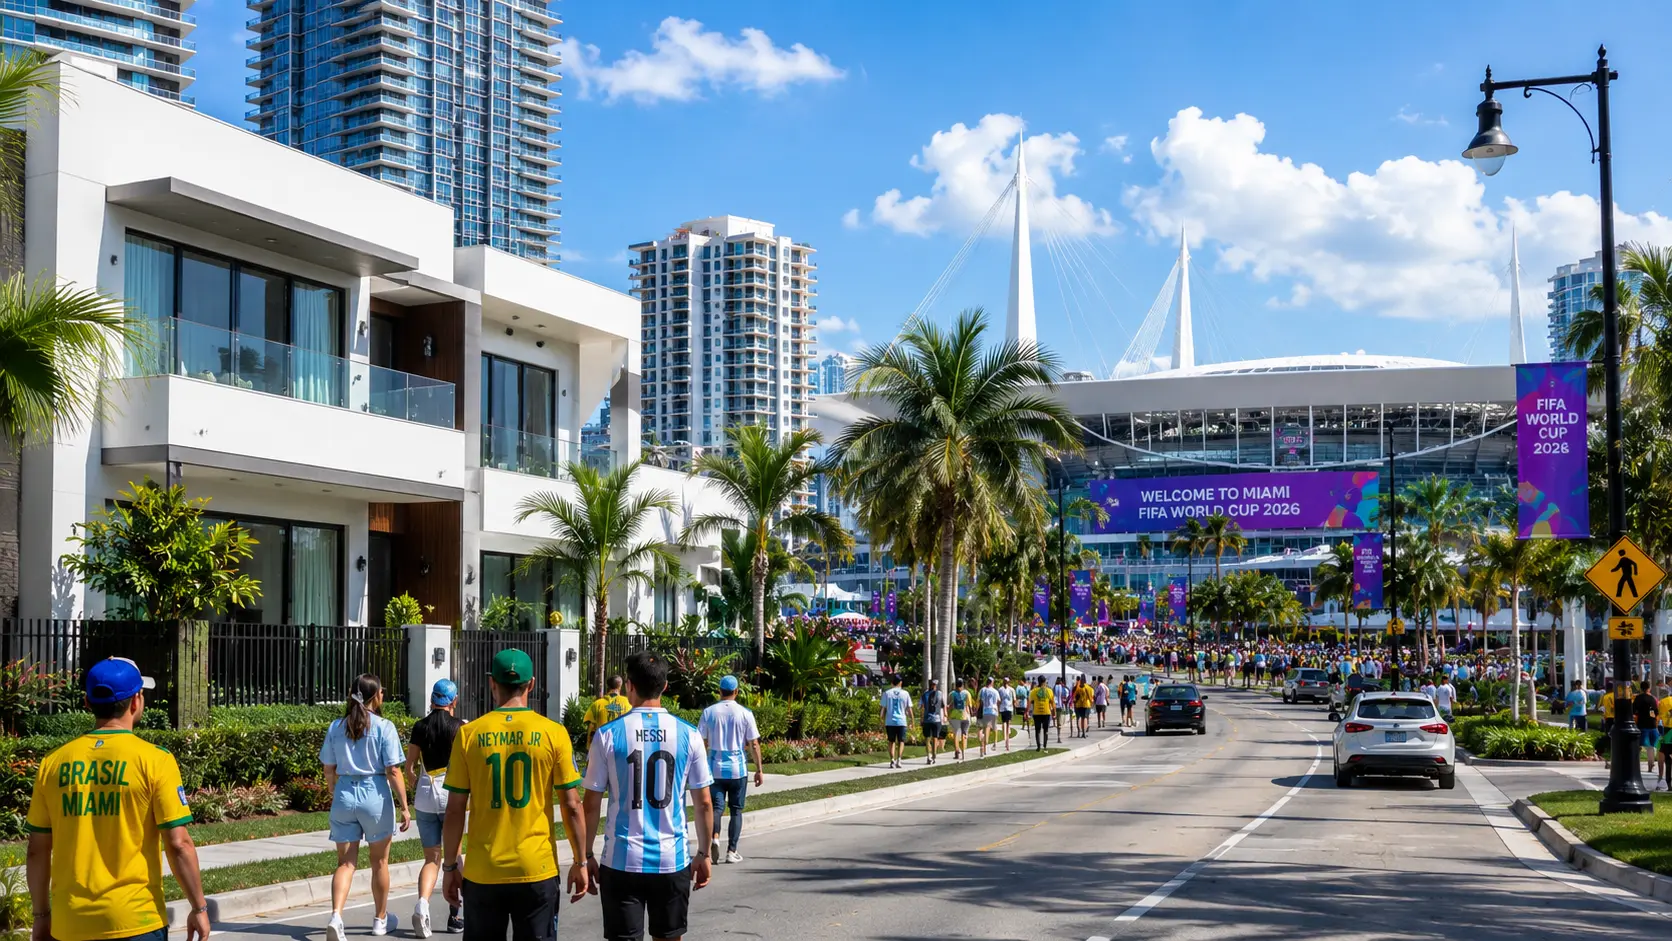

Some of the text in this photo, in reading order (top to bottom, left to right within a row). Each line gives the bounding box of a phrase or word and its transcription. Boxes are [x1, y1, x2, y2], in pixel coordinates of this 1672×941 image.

[1537, 398, 1567, 411] FIFA
[1525, 412, 1579, 425] WORLD
[1538, 427, 1568, 439] CUP
[1141, 485, 1290, 503] WELCOME TO MIAMI
[1138, 502, 1301, 519] FIFA WORLD CUP 2026
[477, 730, 542, 748] NEYMAR JR
[58, 760, 130, 788] BRASIL
[485, 751, 533, 809] 10
[626, 748, 676, 810] 10
[61, 791, 121, 817] MIAMI
